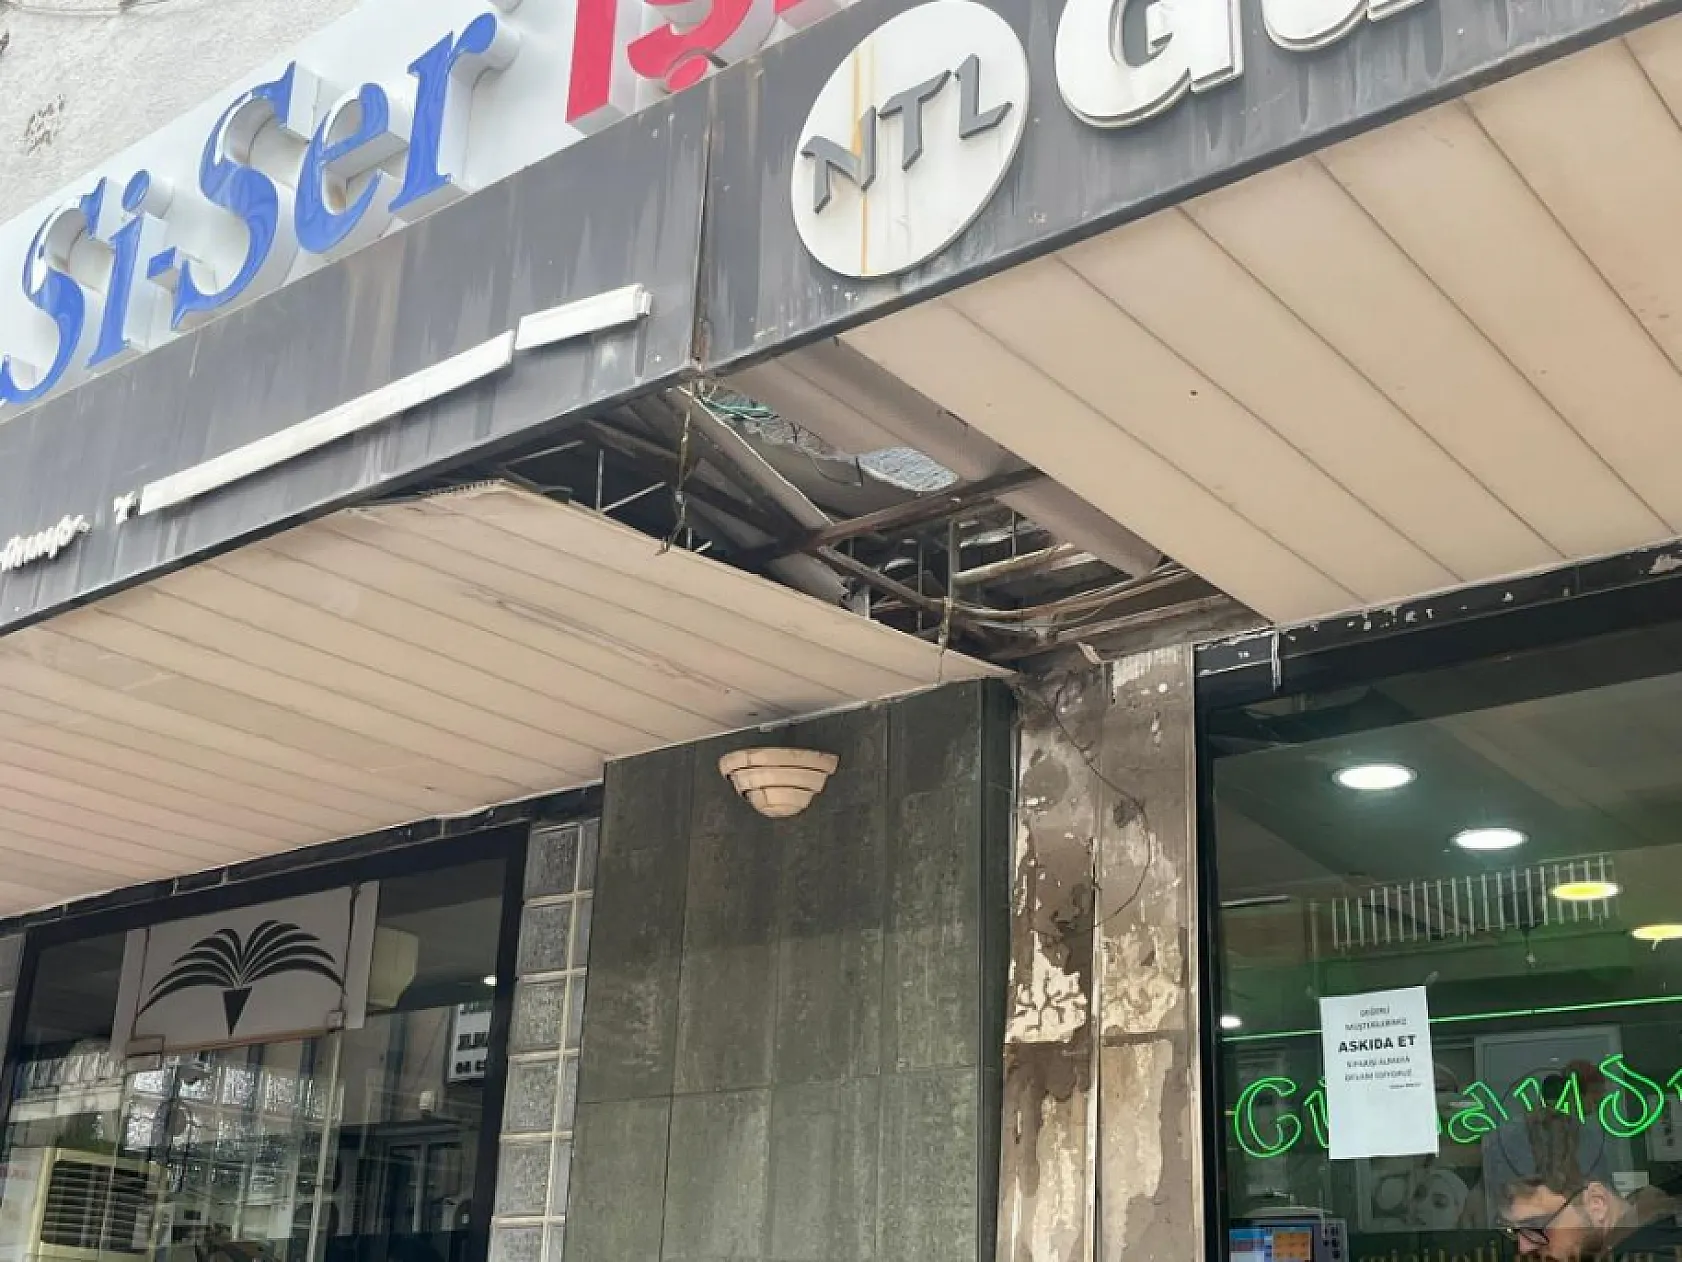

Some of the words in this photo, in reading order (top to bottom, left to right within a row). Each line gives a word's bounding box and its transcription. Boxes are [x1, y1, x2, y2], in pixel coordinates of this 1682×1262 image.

[0, 12, 496, 403] Si-Ser
[800, 53, 1013, 214] NTL
[1338, 1037, 1394, 1053] ASKIDA
[1398, 1034, 1416, 1047] ET
